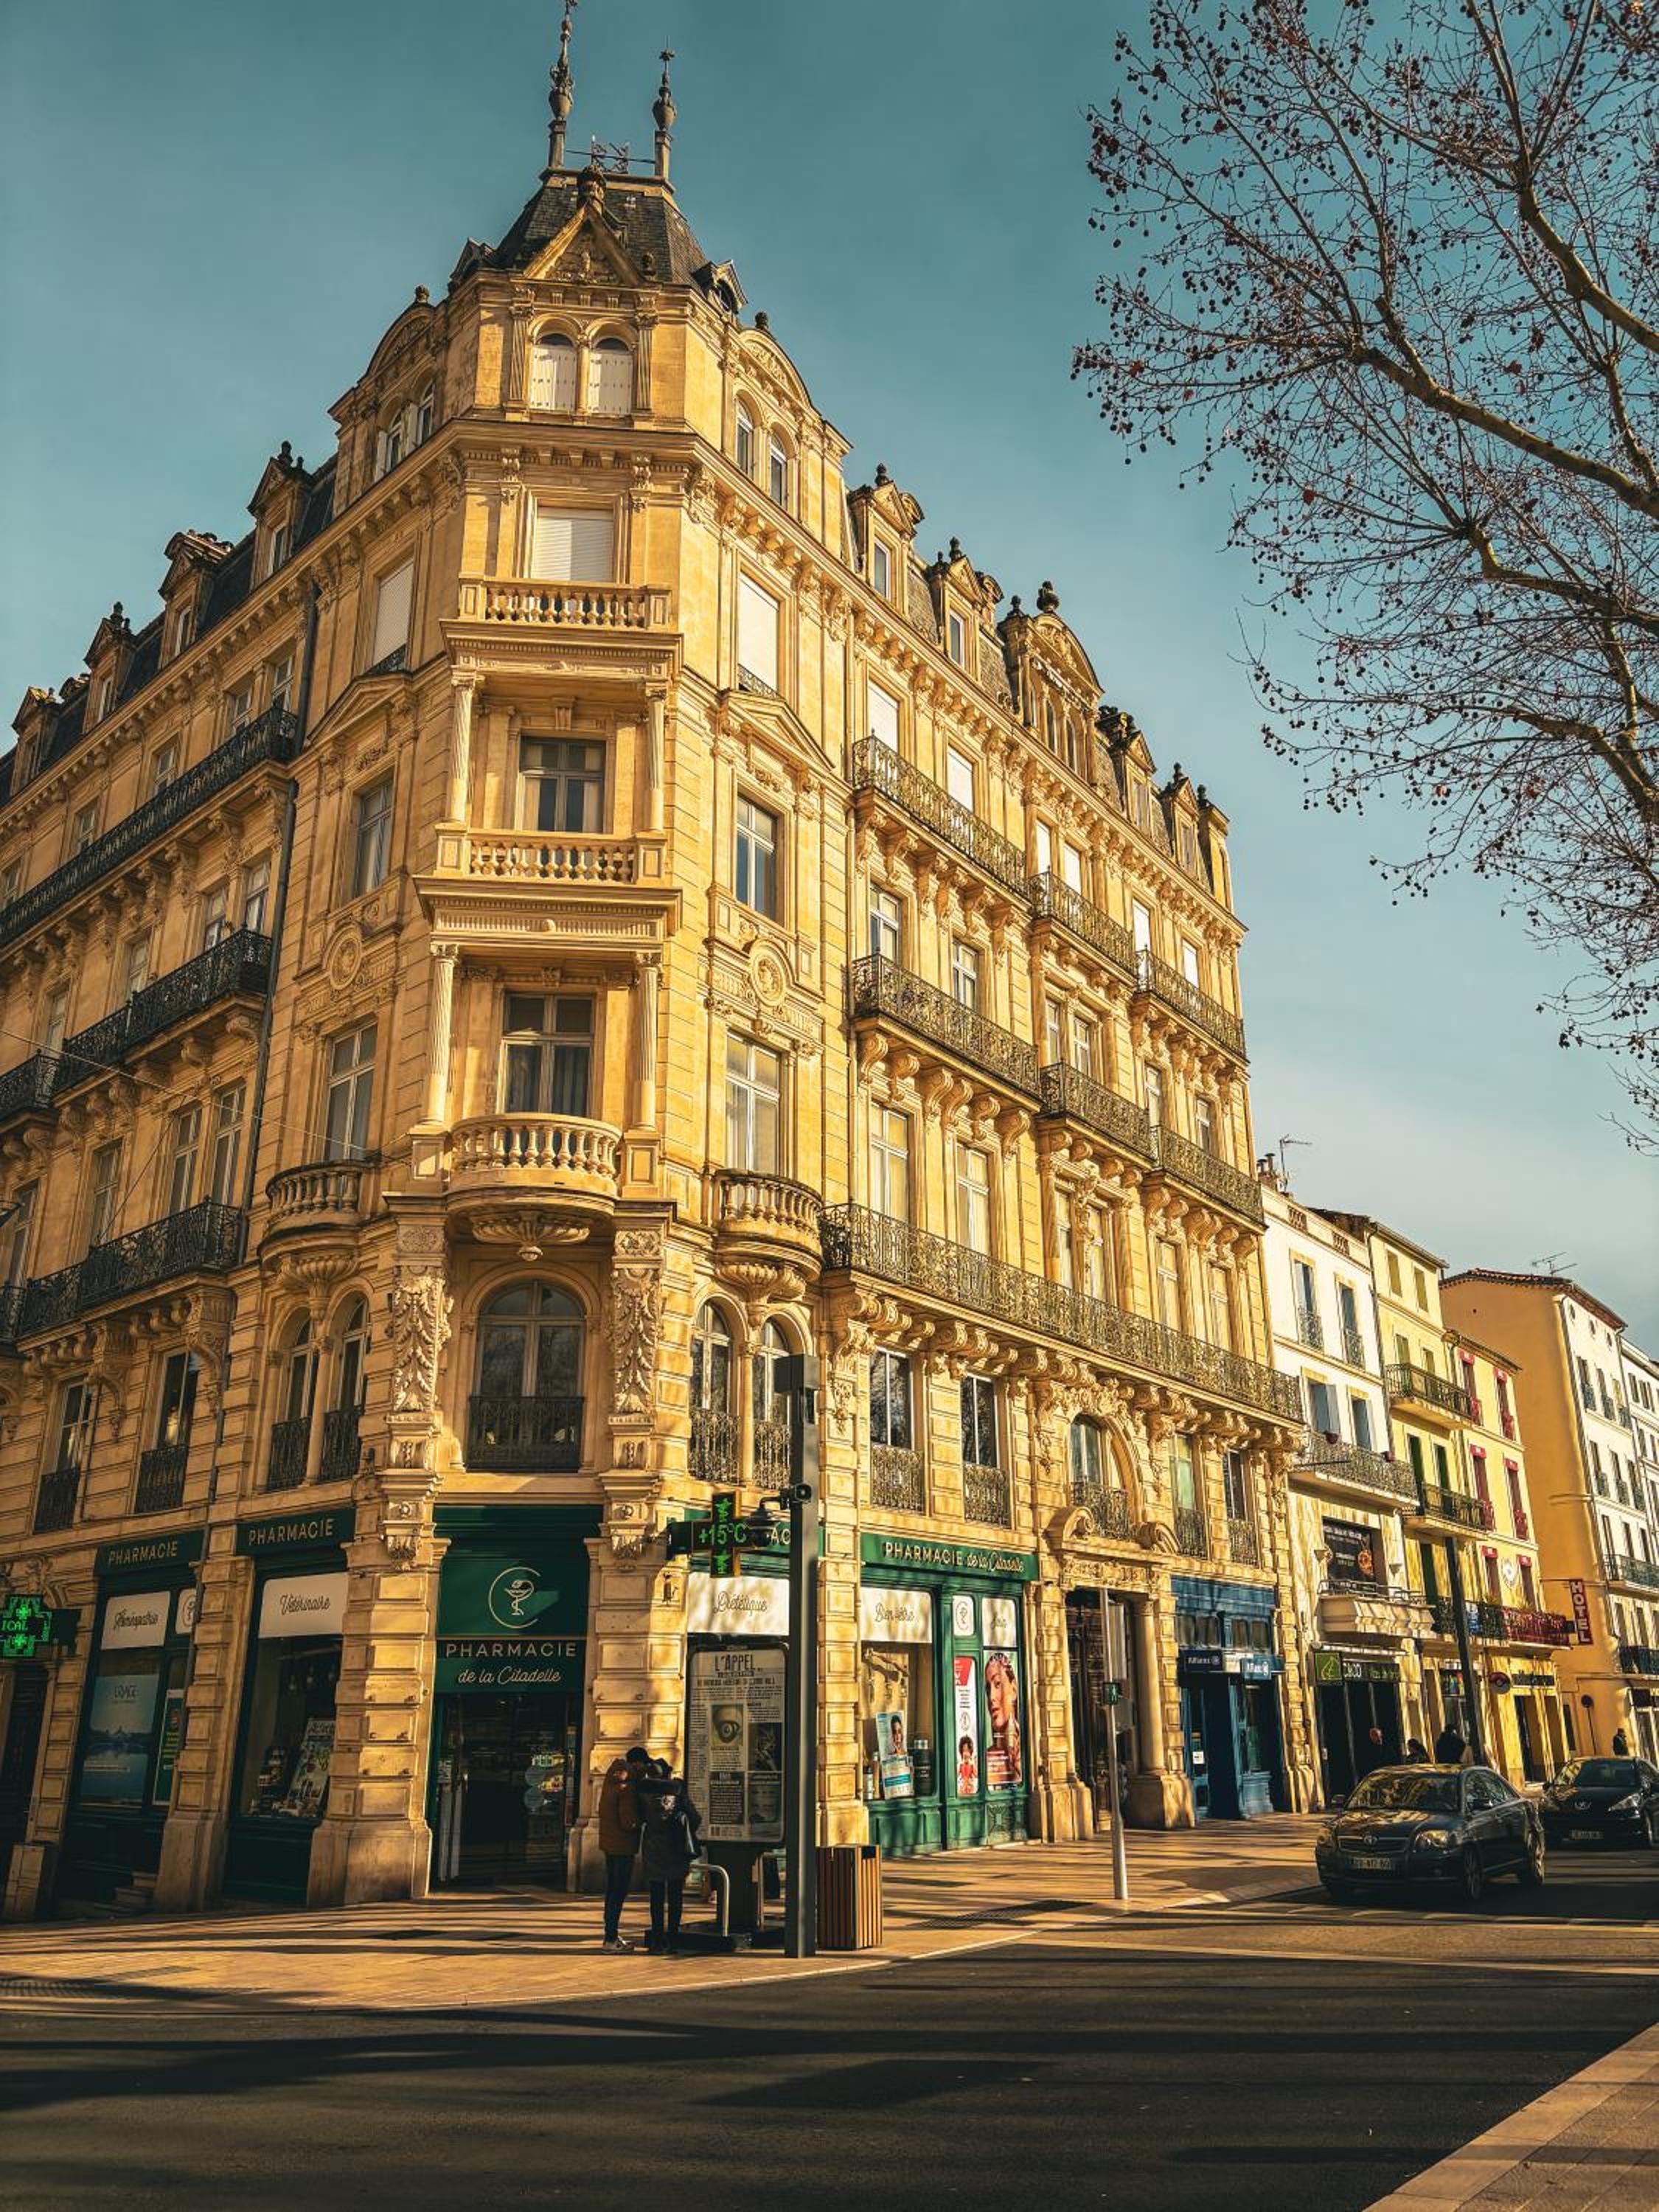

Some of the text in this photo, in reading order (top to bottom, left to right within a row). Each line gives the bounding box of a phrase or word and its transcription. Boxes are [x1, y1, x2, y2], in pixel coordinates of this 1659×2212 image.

[248, 1518, 335, 1546] PHARMACIE
[108, 1540, 178, 1567] PHARMACIE
[885, 1541, 1025, 1572] PHARMACIE de la Citadelle
[1570, 1581, 1590, 1643] HOTEL
[445, 1642, 577, 1658] PHARMACIE
[458, 1666, 562, 1685] de la Citadelle
